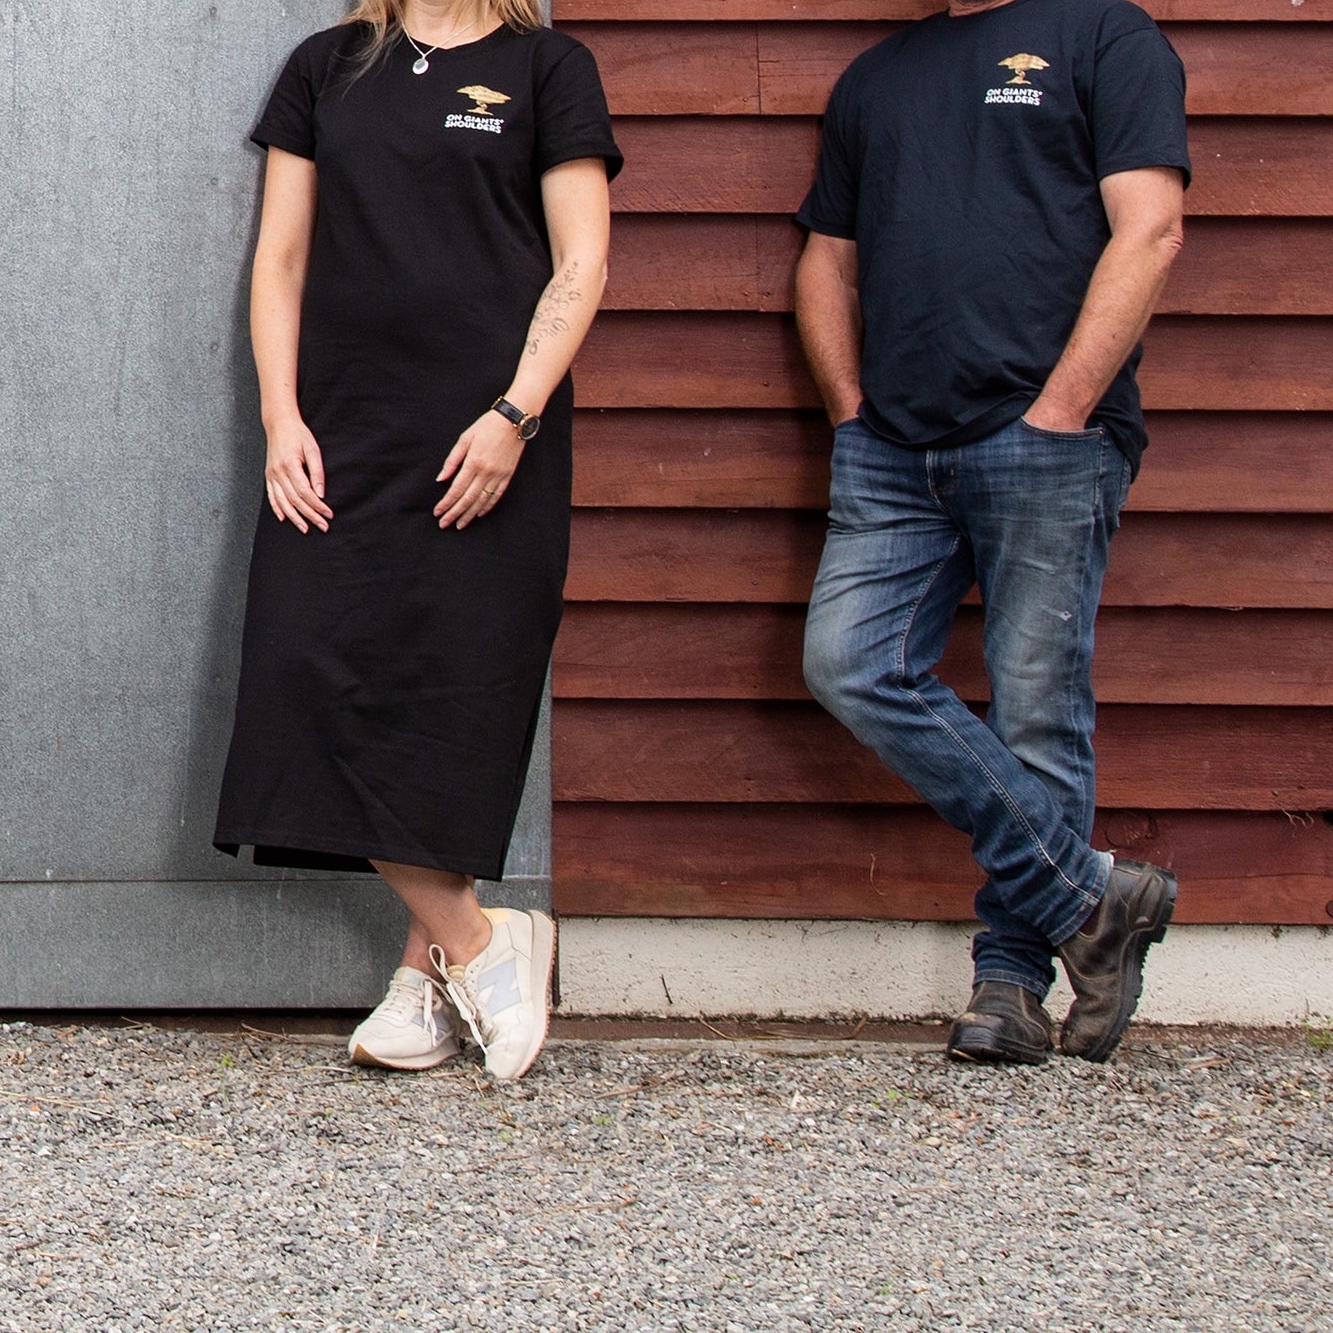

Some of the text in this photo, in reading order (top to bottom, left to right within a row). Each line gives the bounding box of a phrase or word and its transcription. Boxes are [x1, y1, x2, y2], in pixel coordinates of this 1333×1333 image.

[986, 88, 1002, 96] ON
[984, 95, 1041, 106] SHOULDERS
[444, 120, 502, 134] SHOULDERS
